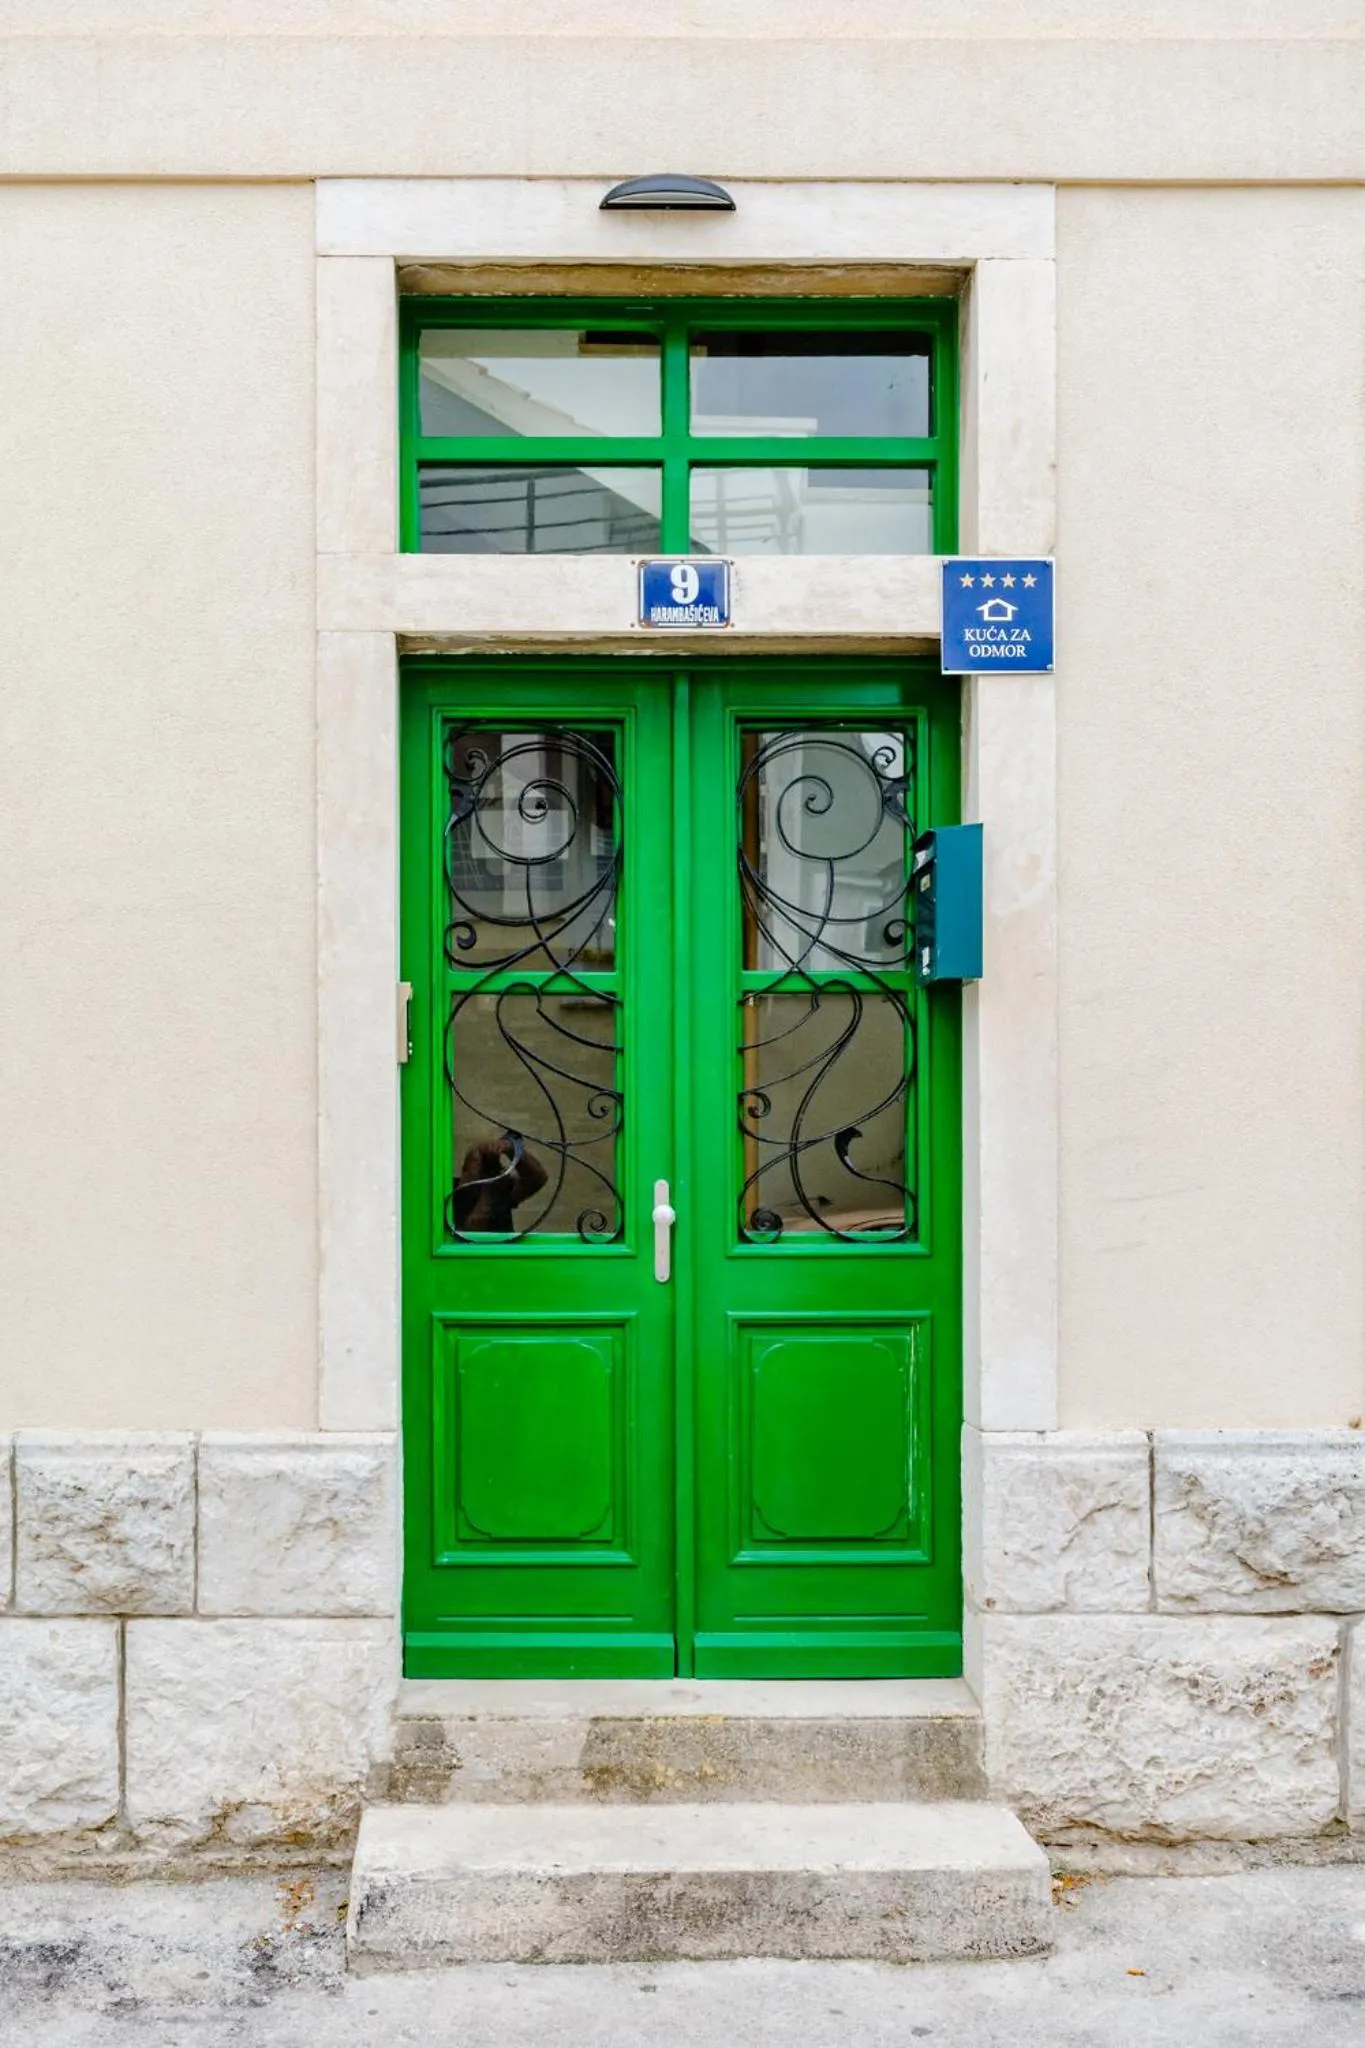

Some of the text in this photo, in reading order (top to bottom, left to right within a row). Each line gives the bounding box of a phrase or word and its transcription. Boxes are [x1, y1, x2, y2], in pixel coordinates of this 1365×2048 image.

[670, 564, 700, 605] 9
[964, 625, 1032, 641] KUĆA ZA
[968, 645, 1027, 657] ODMOR
